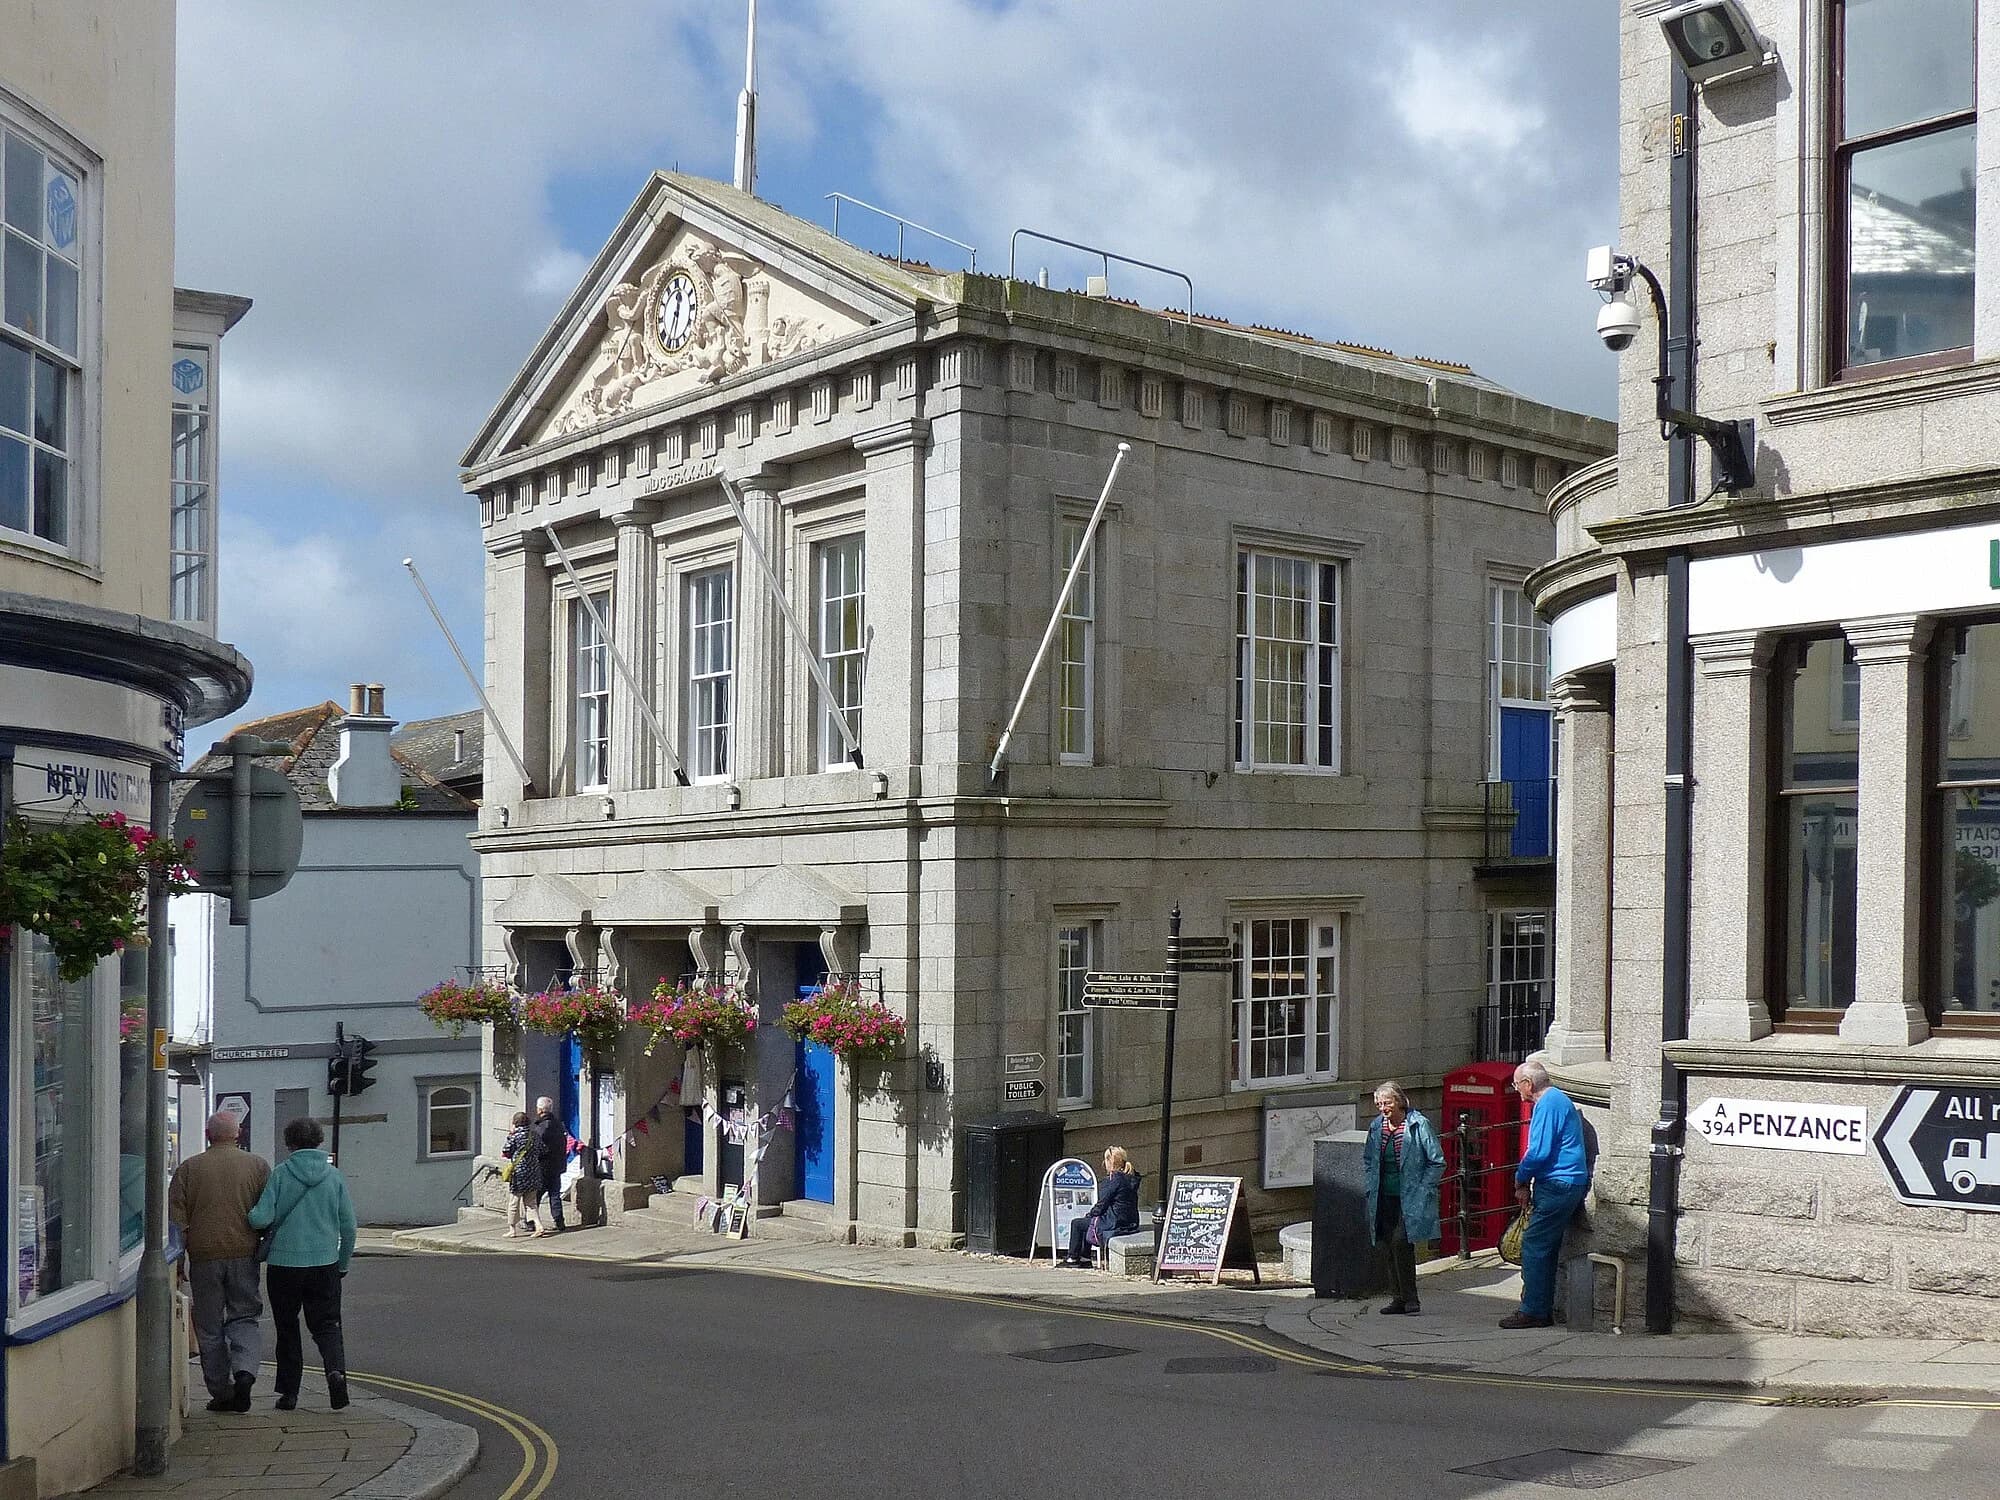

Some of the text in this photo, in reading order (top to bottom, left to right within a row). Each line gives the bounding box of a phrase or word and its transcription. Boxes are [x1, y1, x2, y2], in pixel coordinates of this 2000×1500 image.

[47, 763, 89, 797] NEW
[216, 1049, 286, 1059] CHURCH STREET
[1007, 1090, 1036, 1099] TOILETS
[1009, 1082, 1034, 1091] PUBLIC
[1715, 1103, 1728, 1119] A
[1944, 1096, 1983, 1120] All
[1702, 1119, 1735, 1137] 394
[1738, 1111, 1862, 1142] PENZANCE
